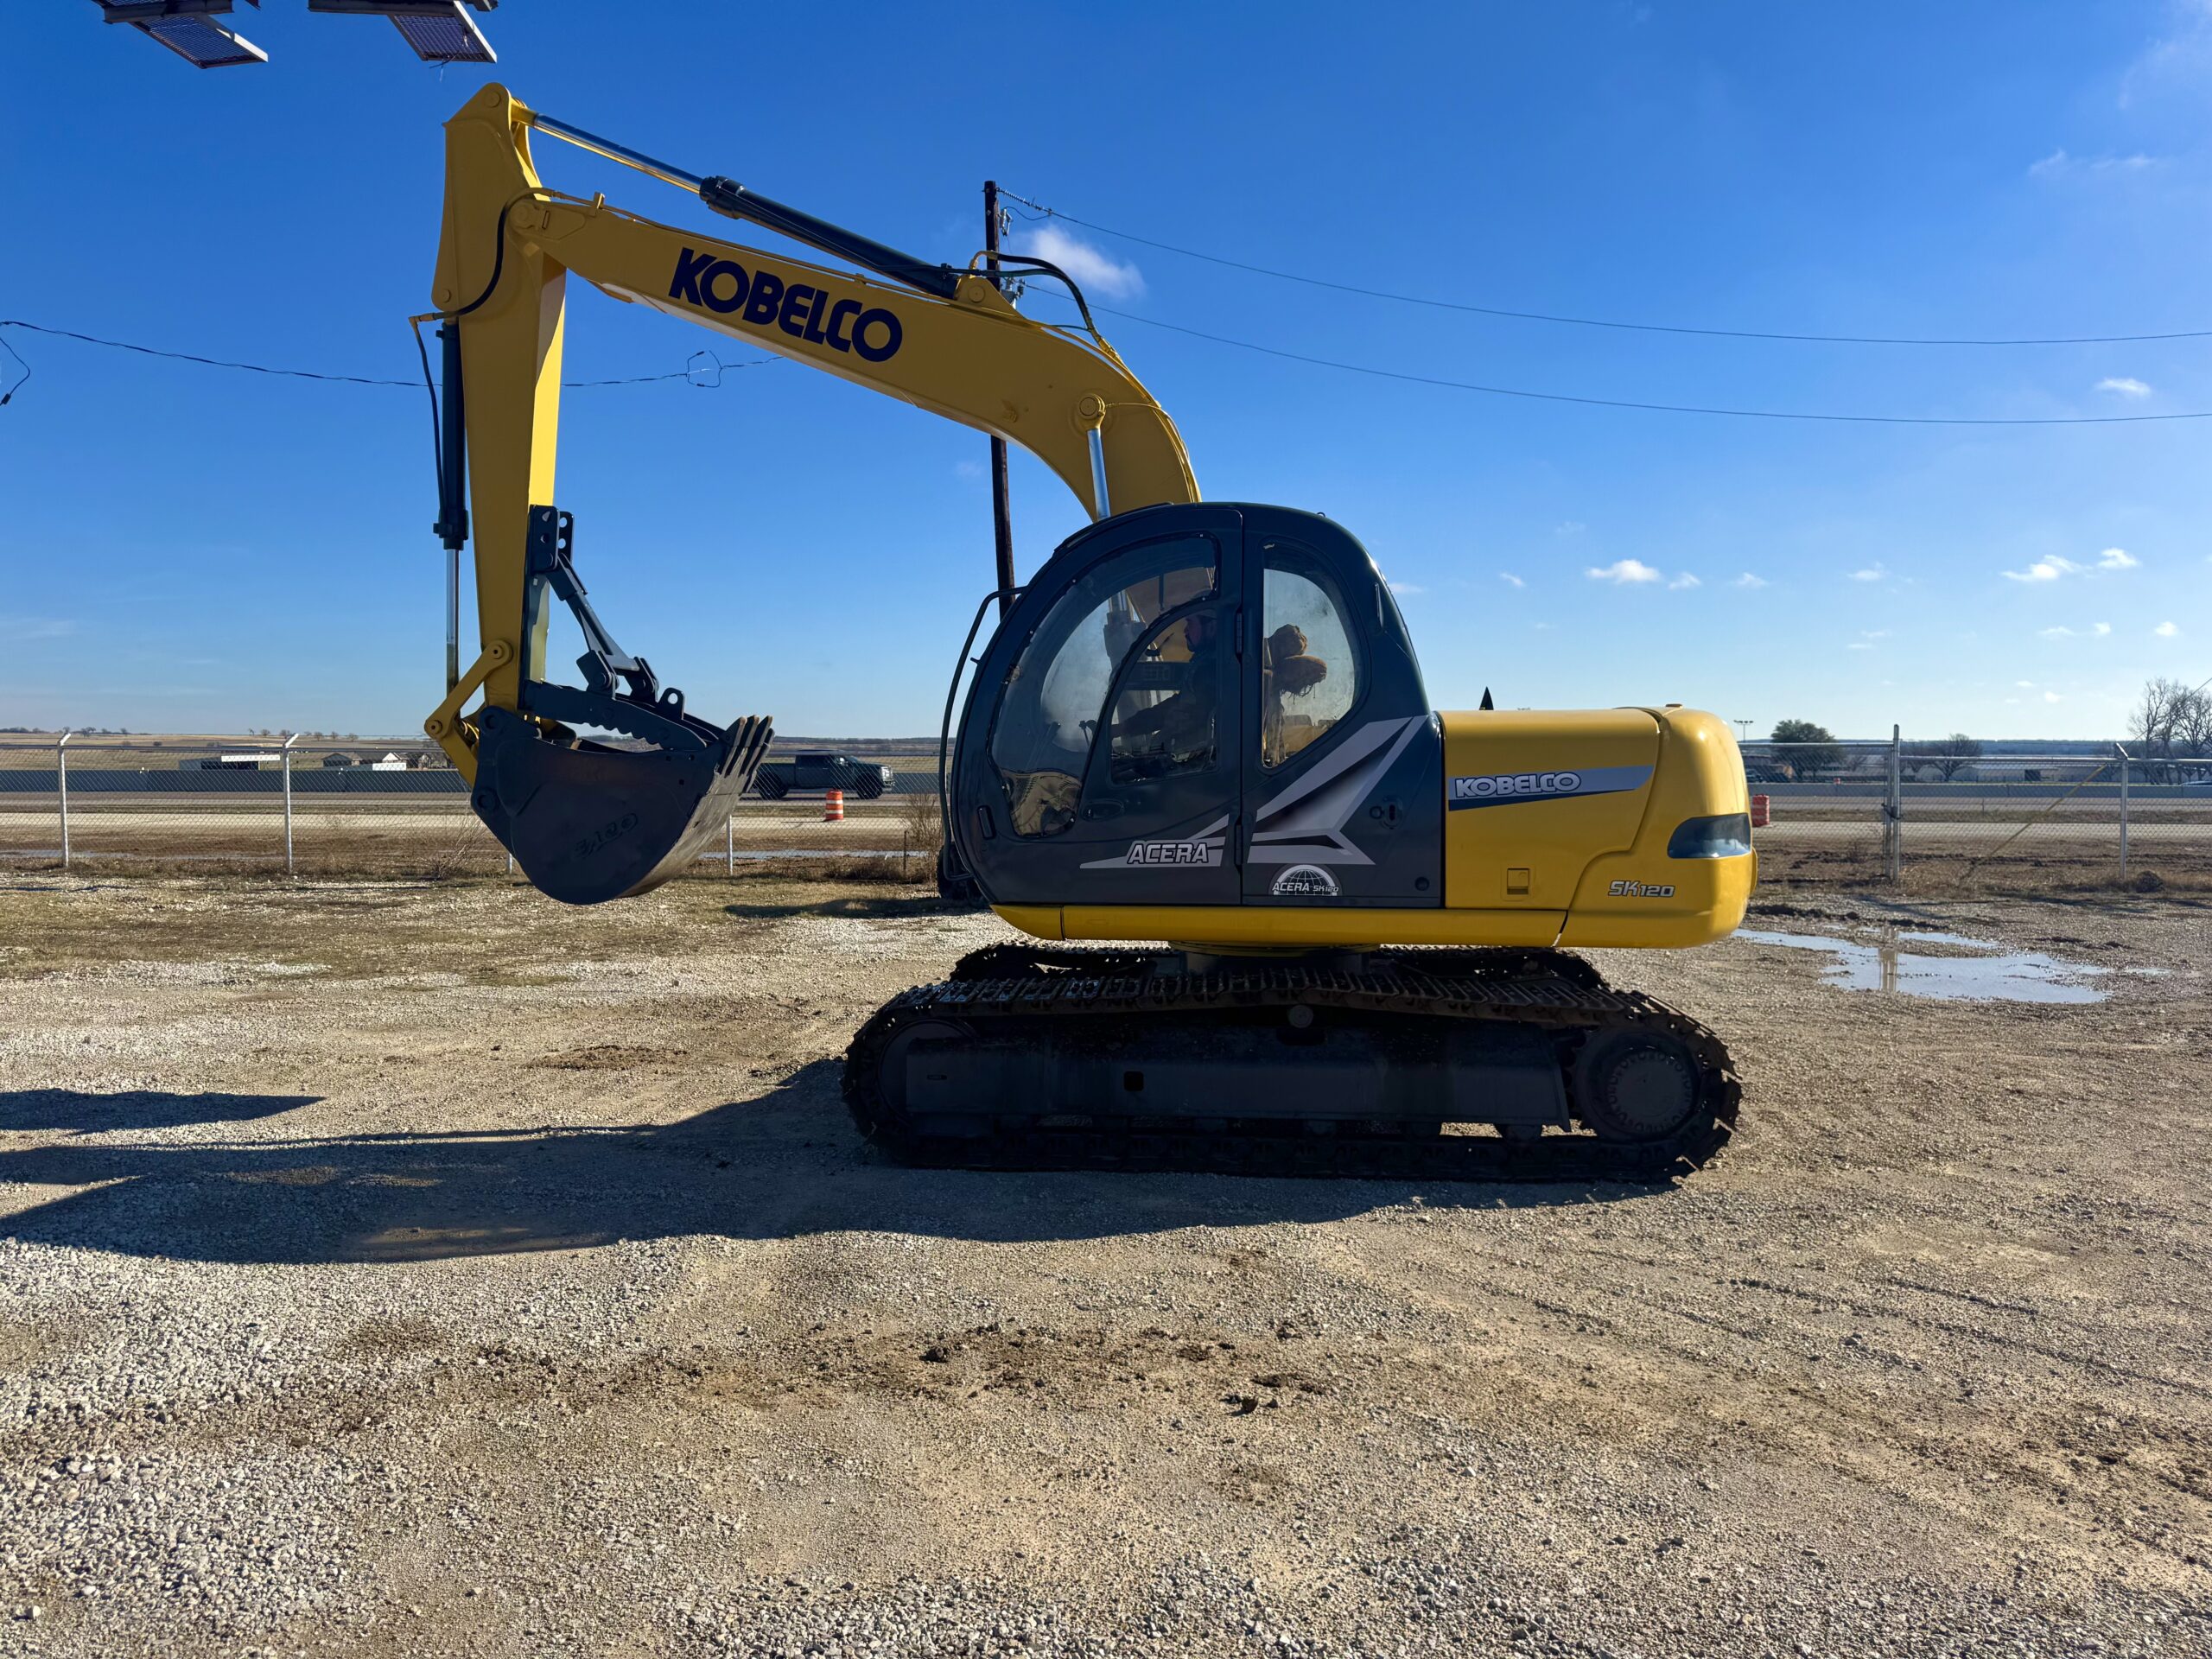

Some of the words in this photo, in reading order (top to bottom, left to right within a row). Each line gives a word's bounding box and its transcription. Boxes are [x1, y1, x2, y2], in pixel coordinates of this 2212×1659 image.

[669, 247, 903, 362] KOBELCO
[1455, 772, 1581, 798] KOBELCO
[1127, 842, 1209, 864] ACERA
[1272, 881, 1309, 891] ACERA
[1608, 880, 1675, 898] SK120
